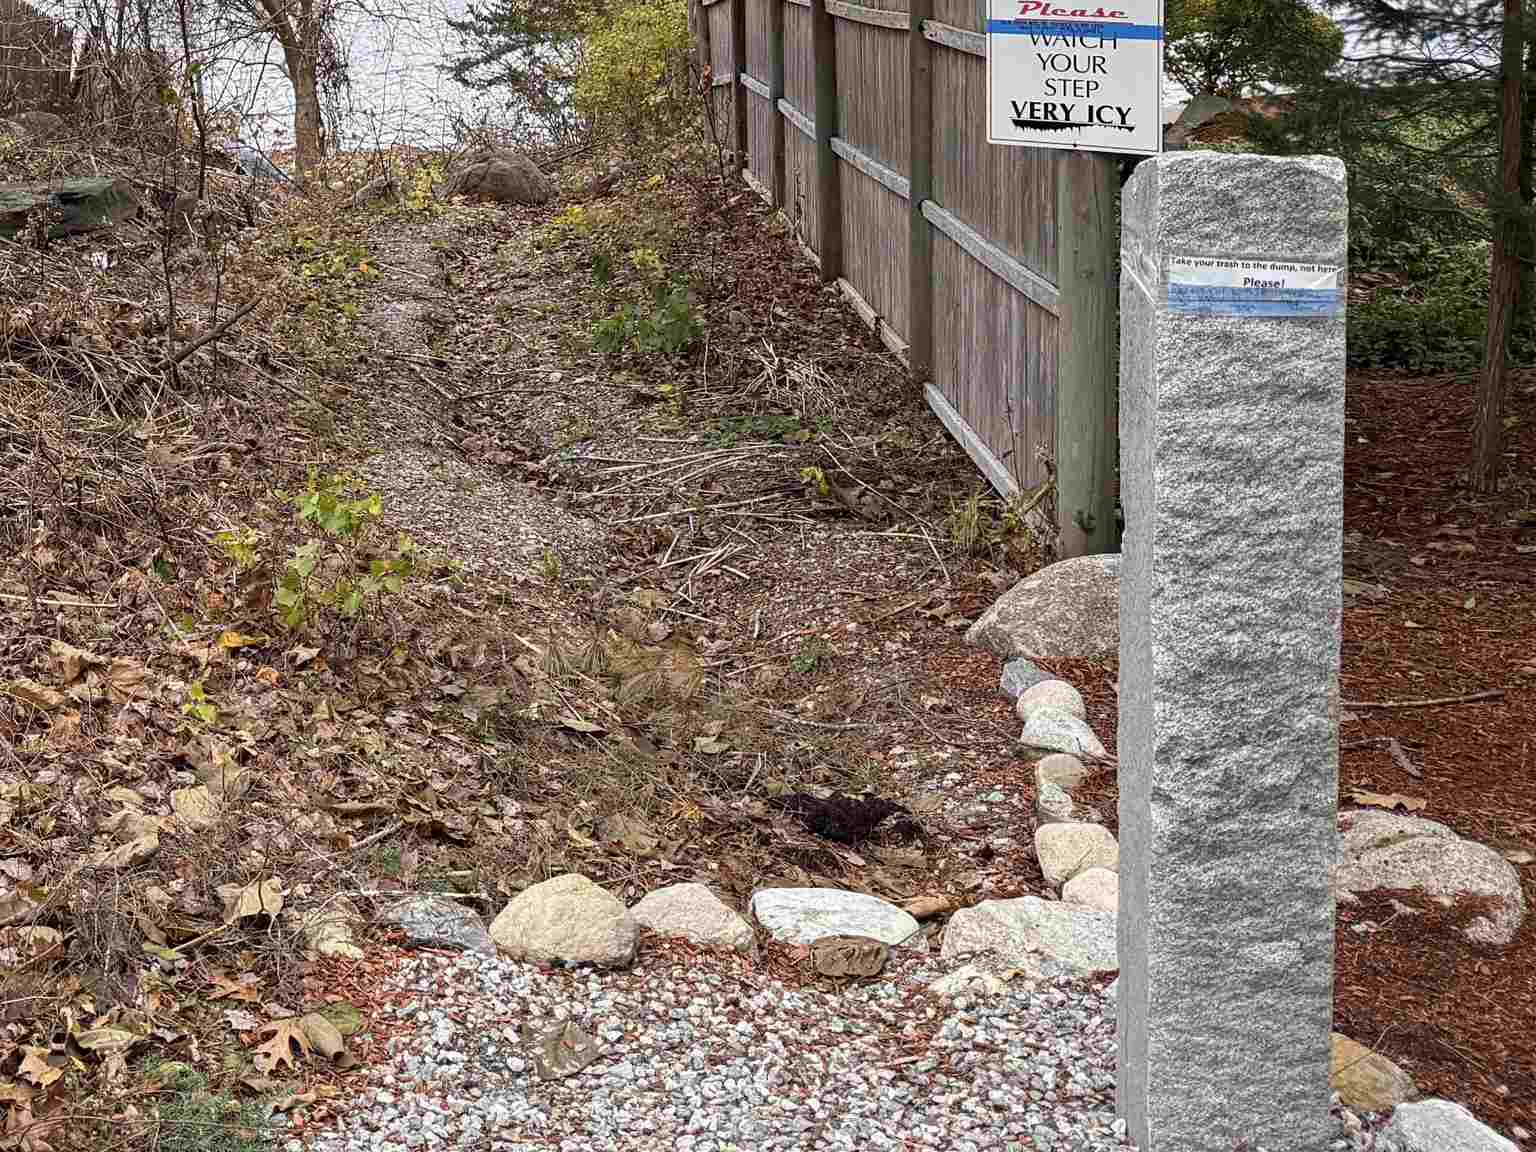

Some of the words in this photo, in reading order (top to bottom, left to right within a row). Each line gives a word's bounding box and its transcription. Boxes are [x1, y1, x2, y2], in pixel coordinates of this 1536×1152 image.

[1017, 0, 1130, 19] Please
[1037, 53, 1108, 75] YOUR
[1044, 78, 1100, 99] STEP
[1011, 100, 1076, 122] VERY
[1087, 104, 1133, 126] ICY
[1194, 259, 1215, 268] your
[1217, 260, 1239, 269] trash
[1241, 261, 1251, 270] to
[1253, 261, 1268, 271] the
[1299, 264, 1315, 273] not
[1243, 276, 1286, 289] Please!
